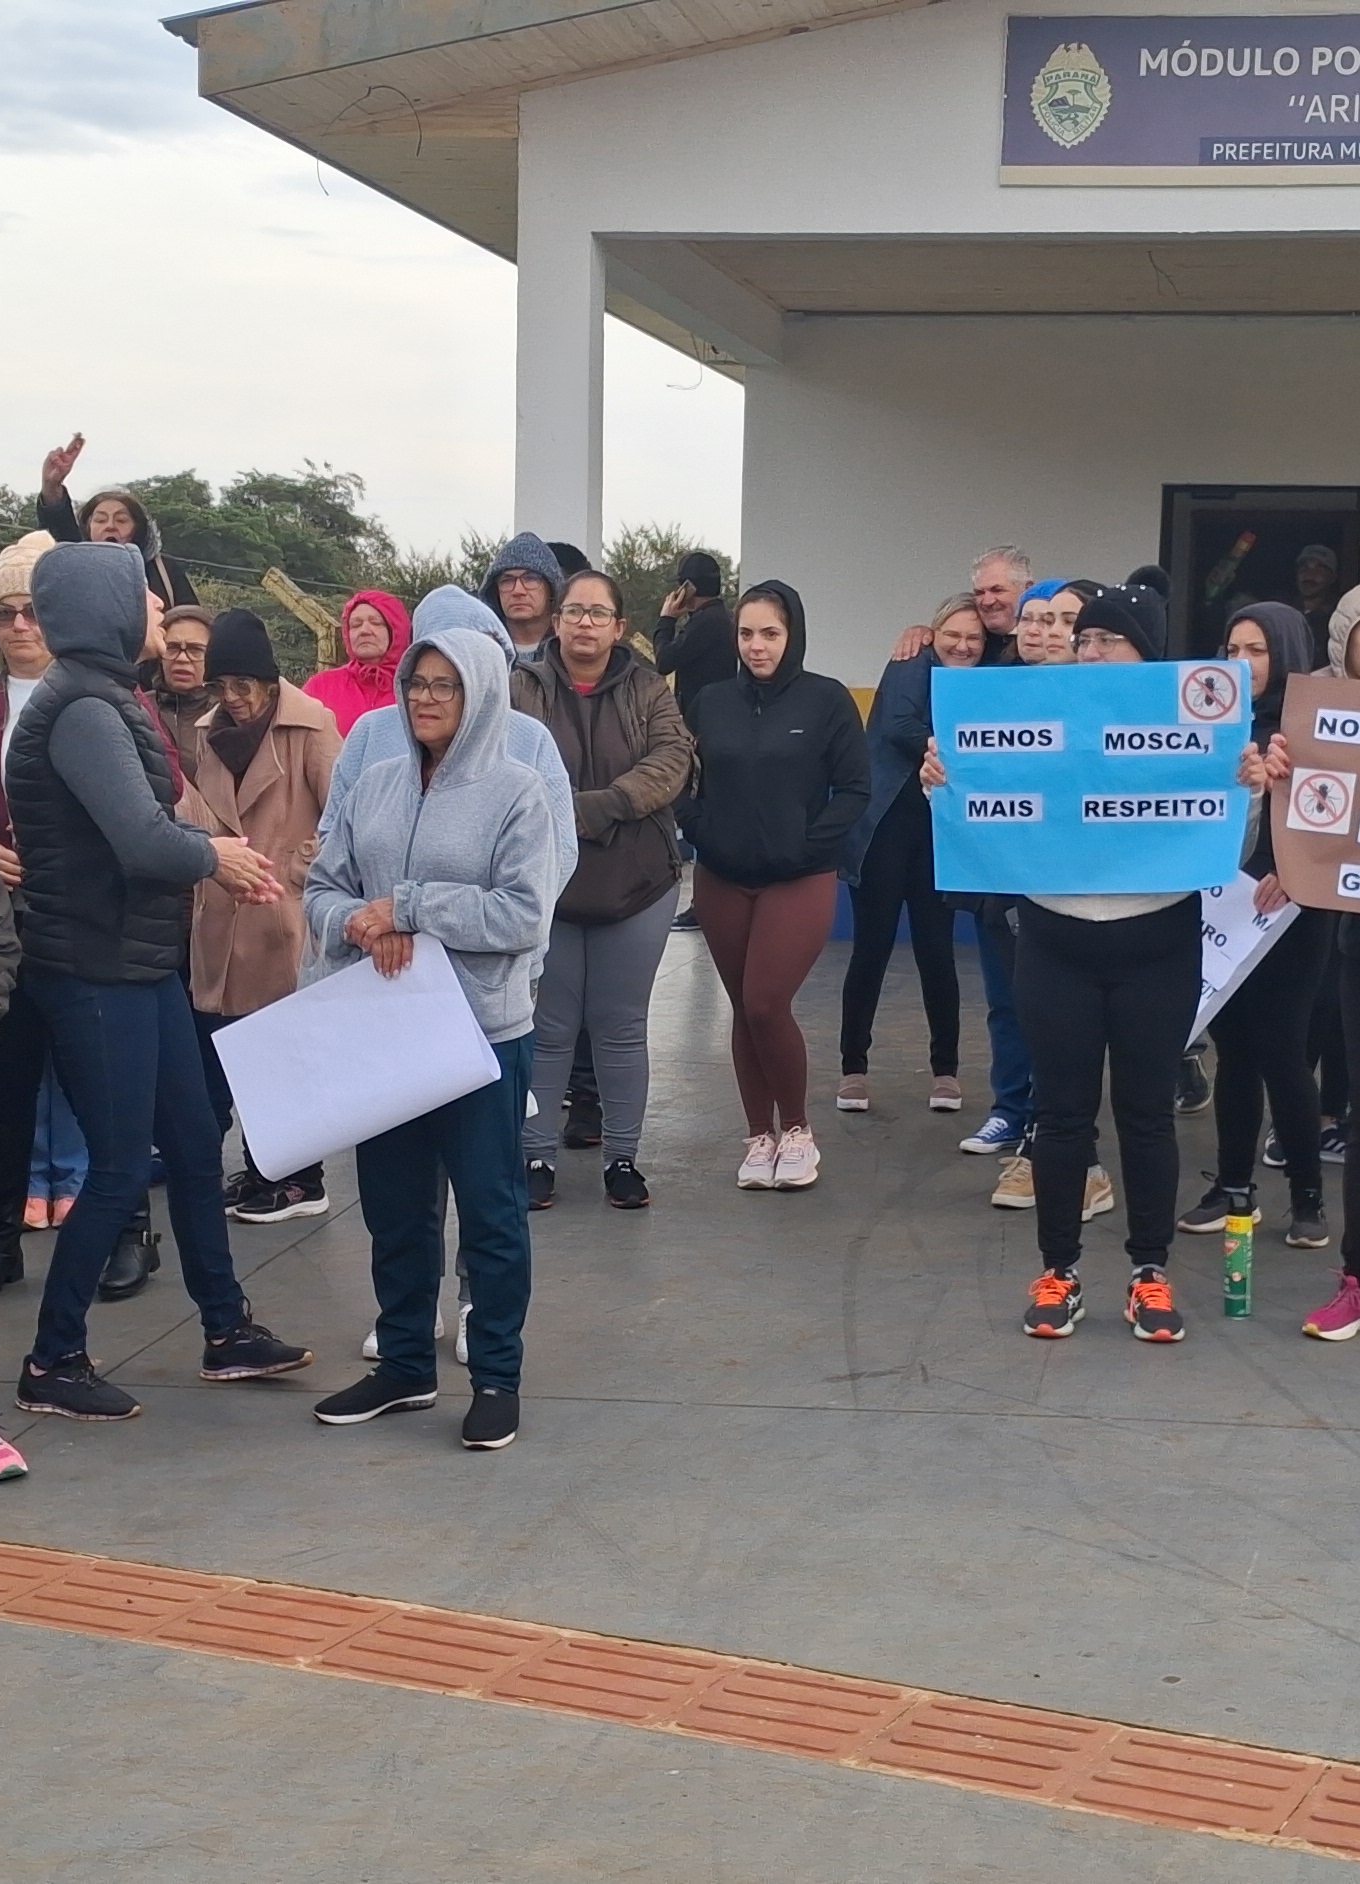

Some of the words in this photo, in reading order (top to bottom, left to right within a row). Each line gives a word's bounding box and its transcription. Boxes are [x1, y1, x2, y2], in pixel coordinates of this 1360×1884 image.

[1139, 41, 1299, 77] MÓDULO
[1212, 142, 1334, 161] PREFEITURA
[958, 728, 1053, 748] MENOS
[1104, 732, 1210, 754] MOSCA,
[968, 799, 1034, 818] MAIS
[1084, 798, 1225, 819] RESPEITO!
